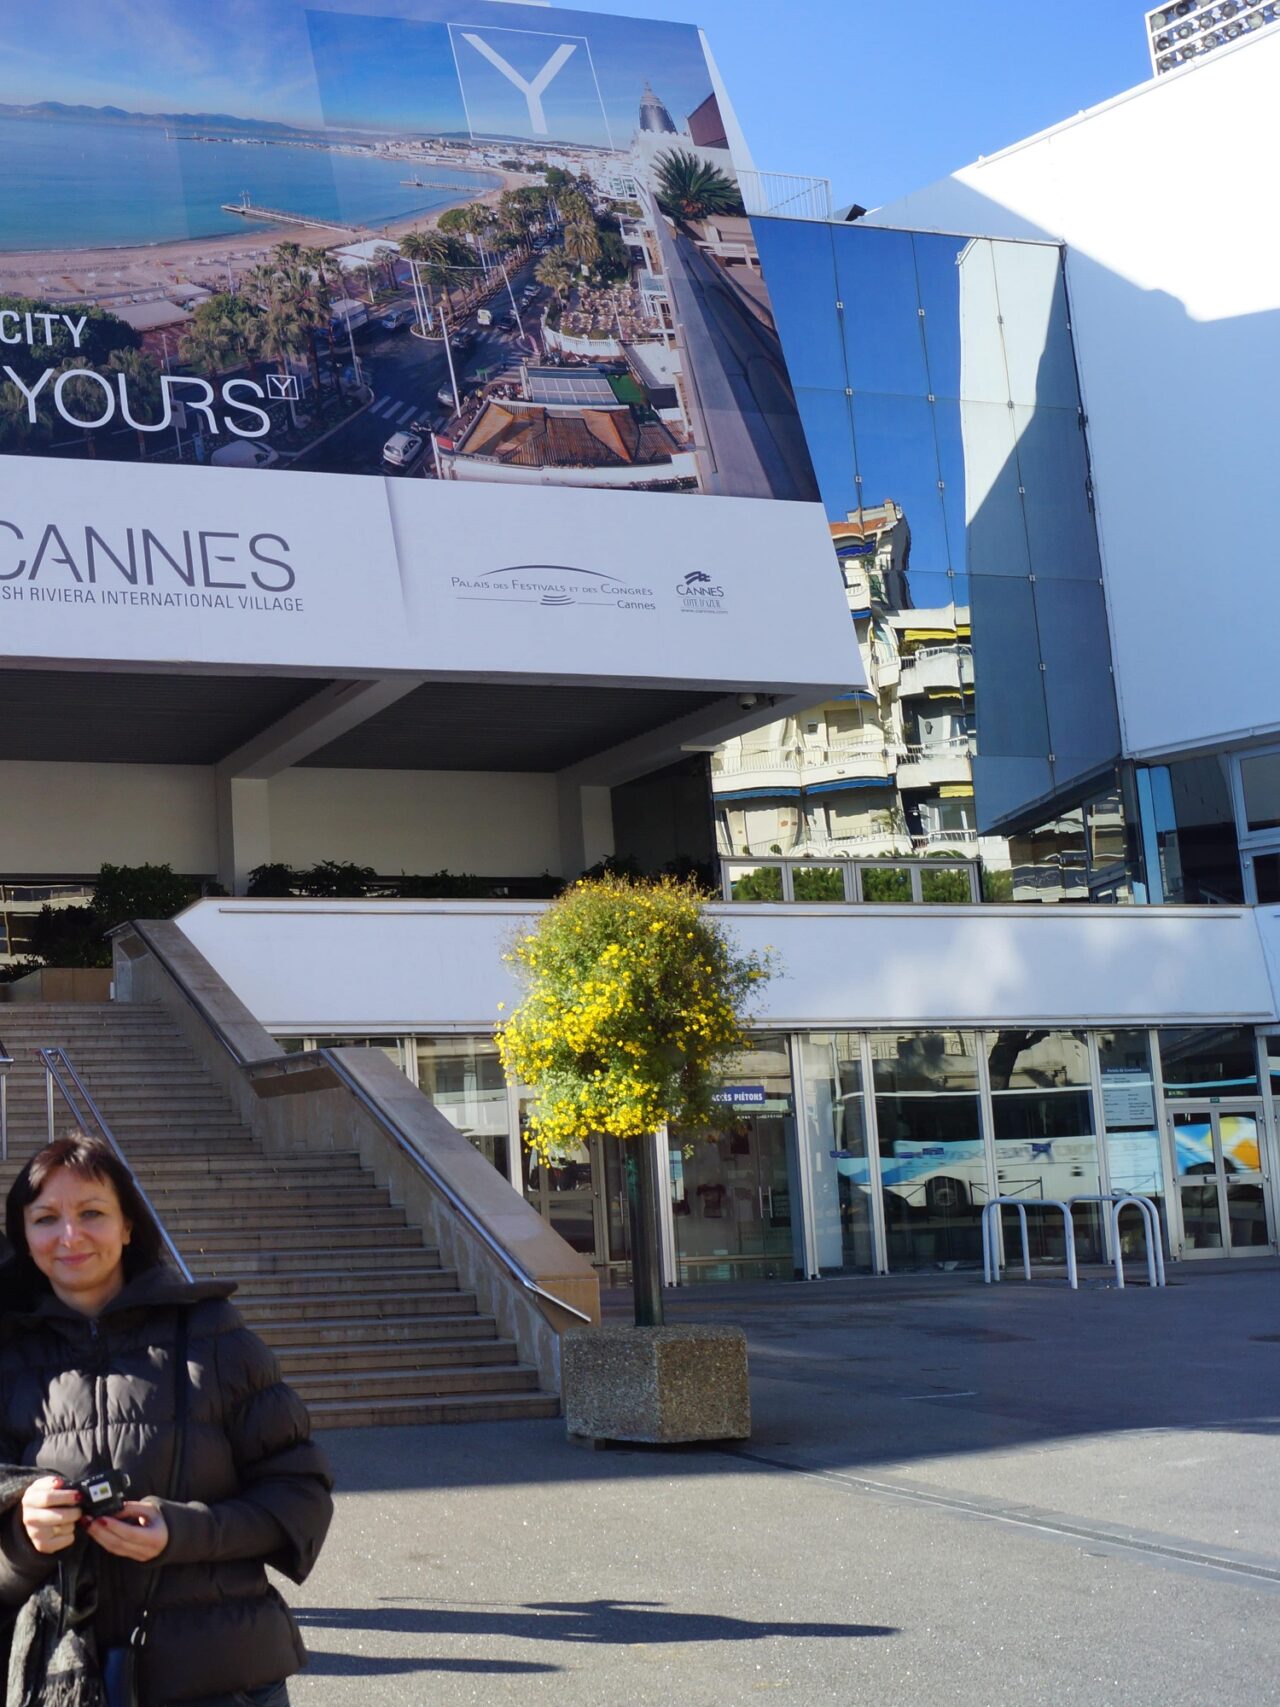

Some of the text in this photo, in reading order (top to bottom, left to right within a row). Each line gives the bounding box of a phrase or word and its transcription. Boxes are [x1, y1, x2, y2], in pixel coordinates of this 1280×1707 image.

[460, 32, 578, 135] Y
[2, 365, 271, 438] YOURS
[29, 587, 97, 604] RIVIERA
[101, 590, 234, 609] INTERNATIONAL
[237, 595, 305, 612] VILLAGE
[676, 584, 724, 598] CANNES
[617, 600, 656, 610] Cannes
